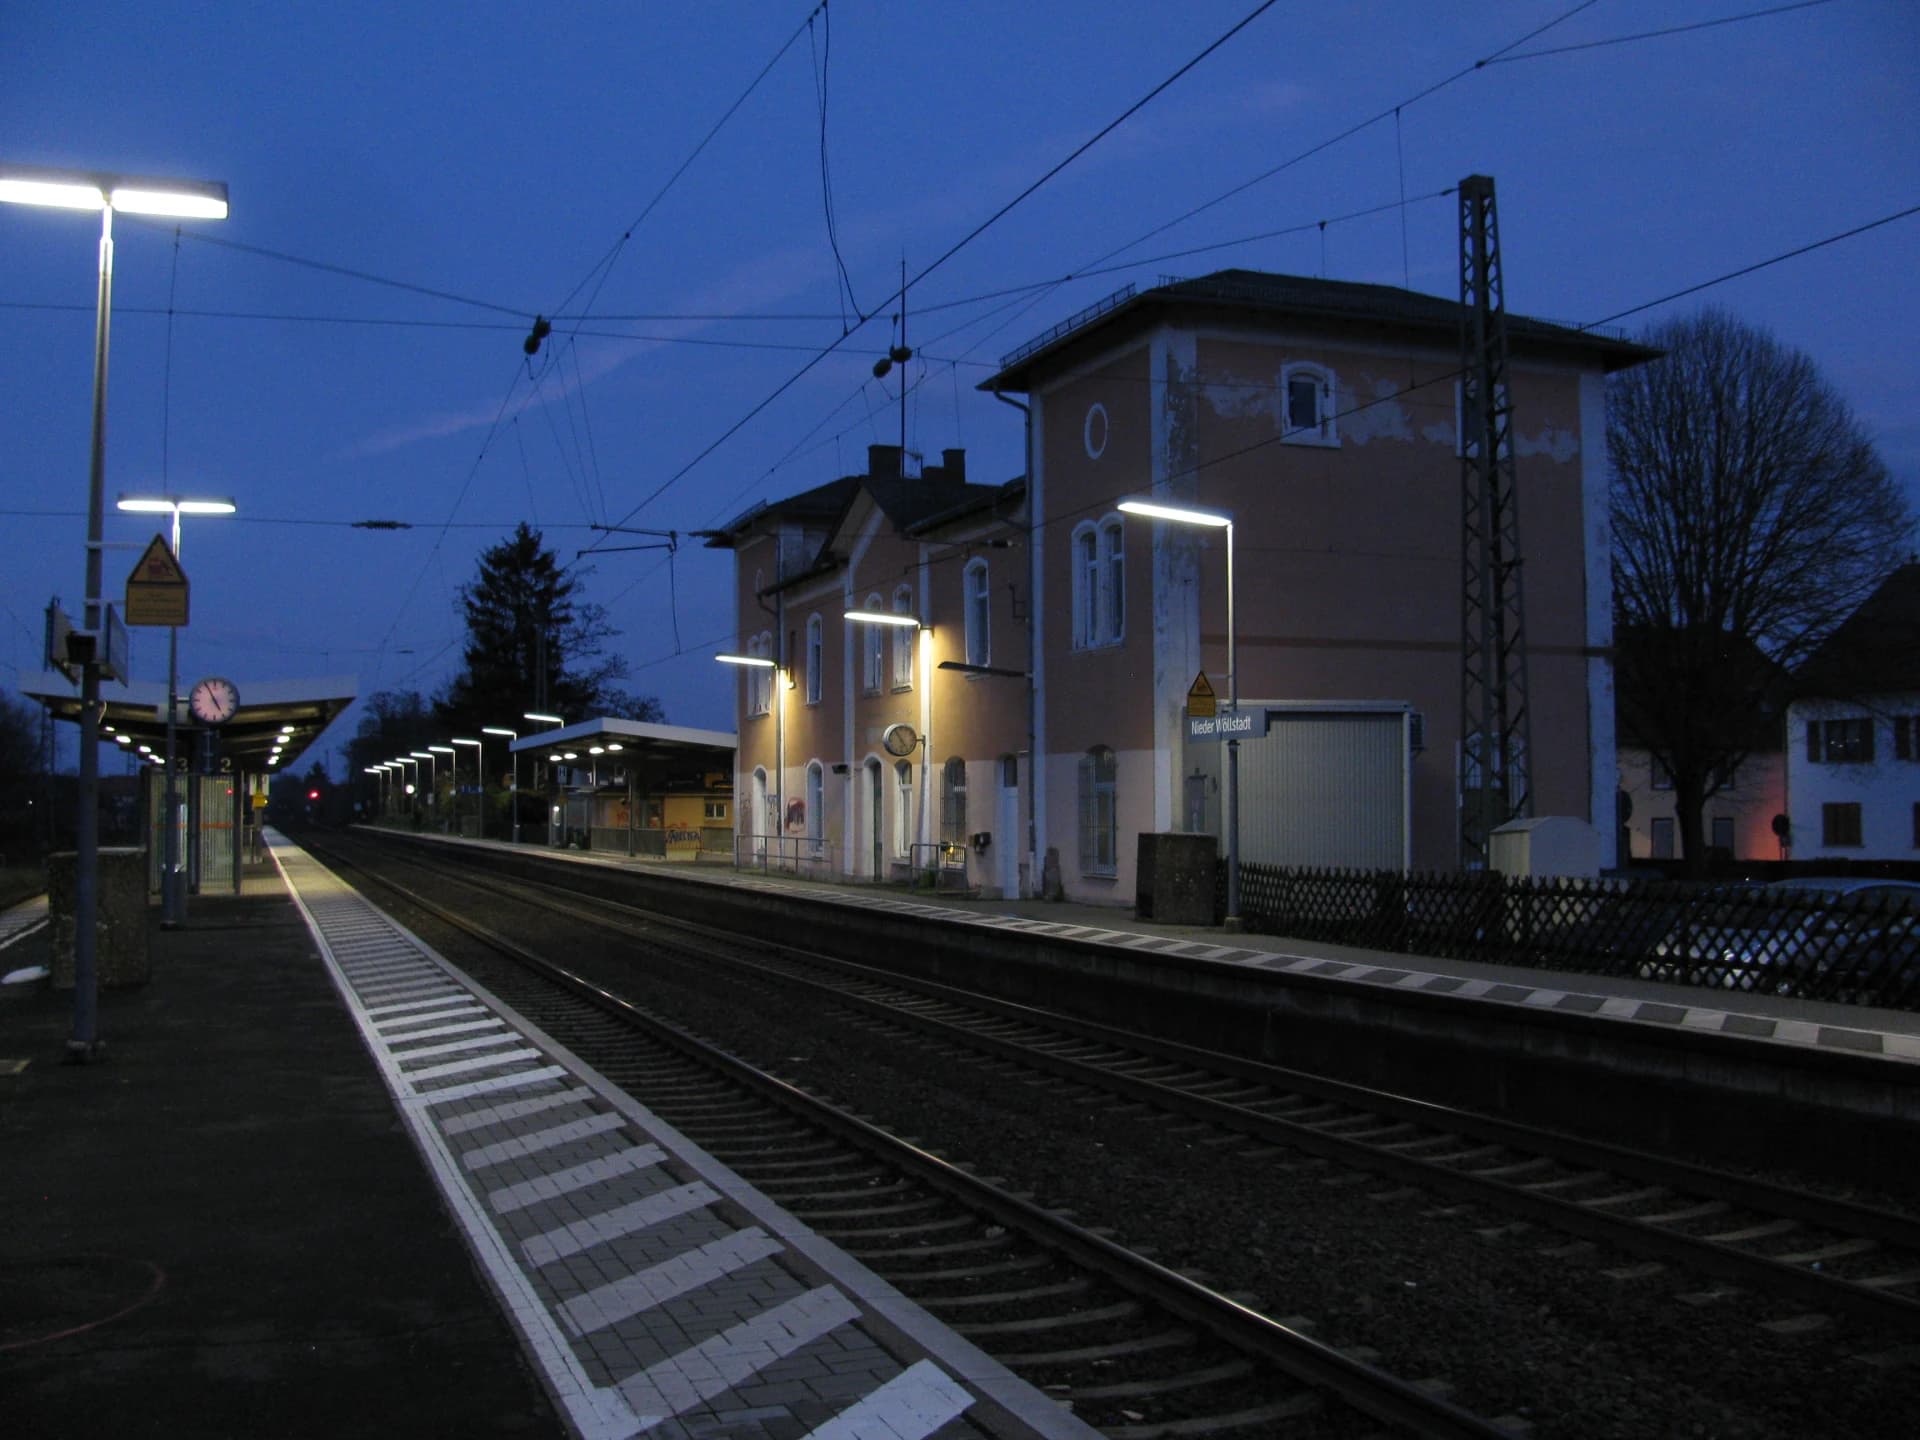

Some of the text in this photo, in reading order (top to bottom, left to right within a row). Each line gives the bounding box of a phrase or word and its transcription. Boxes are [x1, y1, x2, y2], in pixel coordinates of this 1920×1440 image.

[1192, 716, 1251, 736] Nieder Wöllstadt
[220, 757, 233, 773] 2
